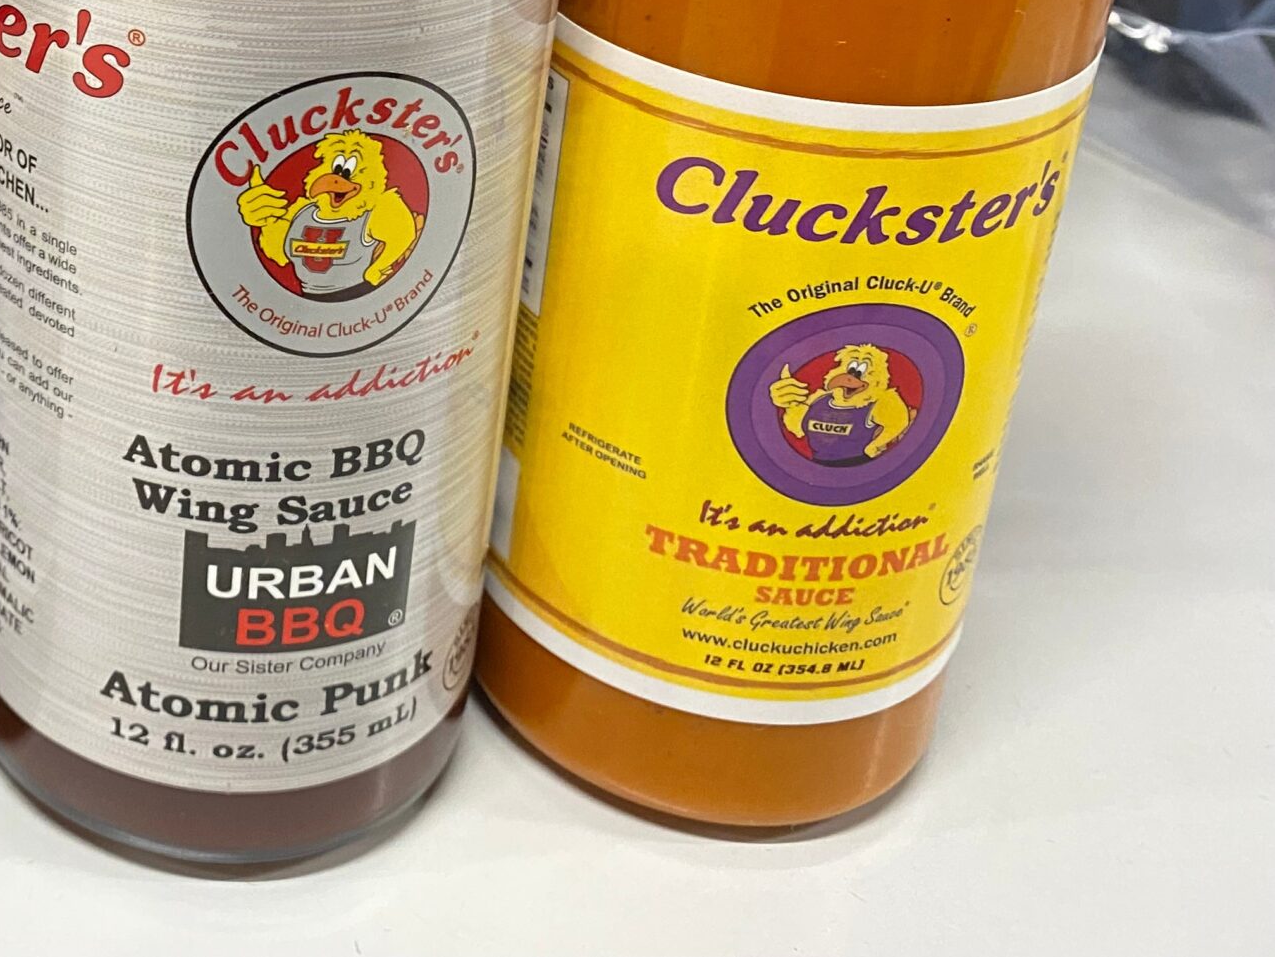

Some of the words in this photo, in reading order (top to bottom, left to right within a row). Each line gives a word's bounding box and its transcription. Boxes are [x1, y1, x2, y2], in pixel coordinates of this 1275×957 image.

[17, 148, 37, 173] OF
[656, 155, 1061, 246] Cluckster's
[30, 225, 37, 236] a
[41, 229, 78, 257] single
[38, 248, 46, 259] a
[48, 252, 77, 275] wide
[28, 287, 77, 321] different
[231, 283, 258, 314] The
[260, 306, 323, 339] Original
[394, 269, 434, 313] Brand
[747, 297, 783, 319] The
[787, 276, 859, 303] Original
[940, 288, 977, 319] Brand
[28, 305, 76, 338] devoted
[28, 371, 49, 391] add
[53, 386, 74, 403] our
[32, 354, 43, 369] to
[46, 364, 75, 386] offer
[151, 362, 217, 400] It's
[230, 385, 293, 404] an
[19, 381, 65, 420] anything
[567, 421, 642, 465] REFRIGERATE
[811, 422, 850, 433] CLUCK
[122, 433, 312, 483] Atomic
[329, 428, 426, 479] BBQ
[561, 430, 593, 455] AFTER
[594, 446, 647, 479] OPENING
[131, 476, 261, 535] Wing
[276, 481, 414, 526] Sauce
[699, 499, 740, 531] It's
[748, 517, 788, 537] an
[644, 523, 951, 583] TRADITIONAL
[205, 545, 398, 601] URBAN
[681, 596, 747, 625] World's
[749, 610, 823, 632] Greatest
[823, 608, 862, 634] Wing
[754, 585, 857, 607] SAUCE
[235, 597, 367, 646] BBQ
[191, 655, 229, 673] Our
[236, 658, 294, 675] Sister
[299, 640, 387, 672] Company
[681, 627, 898, 656] www.cluckuchicken.com
[704, 653, 722, 667] 12
[726, 658, 746, 672] FL
[753, 660, 773, 673] OZ
[99, 670, 300, 723] Atomic
[320, 648, 434, 717] Punk
[110, 716, 150, 746] 12
[163, 732, 196, 756] fl.
[212, 744, 265, 760] oz.
[281, 723, 357, 763] (355
[367, 696, 418, 738] mL)
